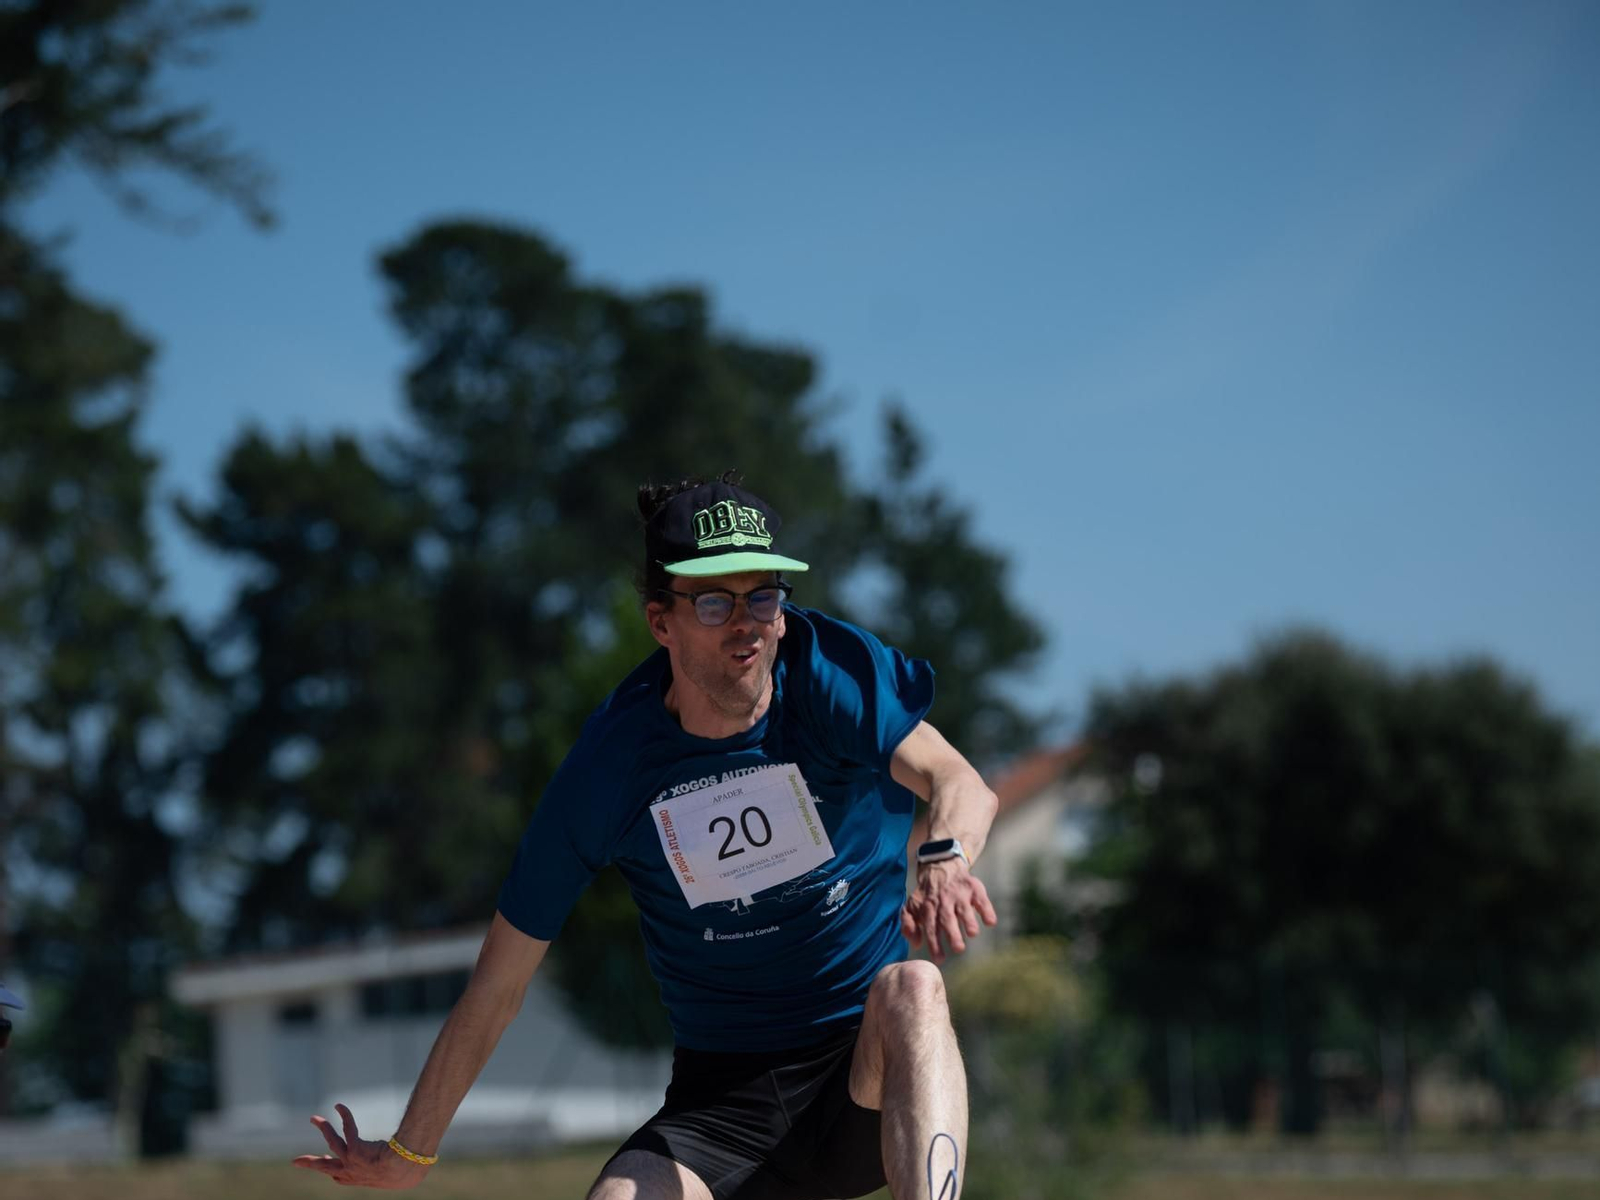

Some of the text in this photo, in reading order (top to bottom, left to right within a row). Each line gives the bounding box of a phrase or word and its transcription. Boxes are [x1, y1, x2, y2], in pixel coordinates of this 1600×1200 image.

[692, 500, 771, 541] OBEY
[670, 775, 718, 797] XOGOS
[712, 787, 744, 804] APADER
[659, 809, 681, 850] ATLETISMO
[708, 806, 772, 860] 20
[672, 851, 690, 873] XOGOS
[716, 925, 780, 940] Concello da Coruña
